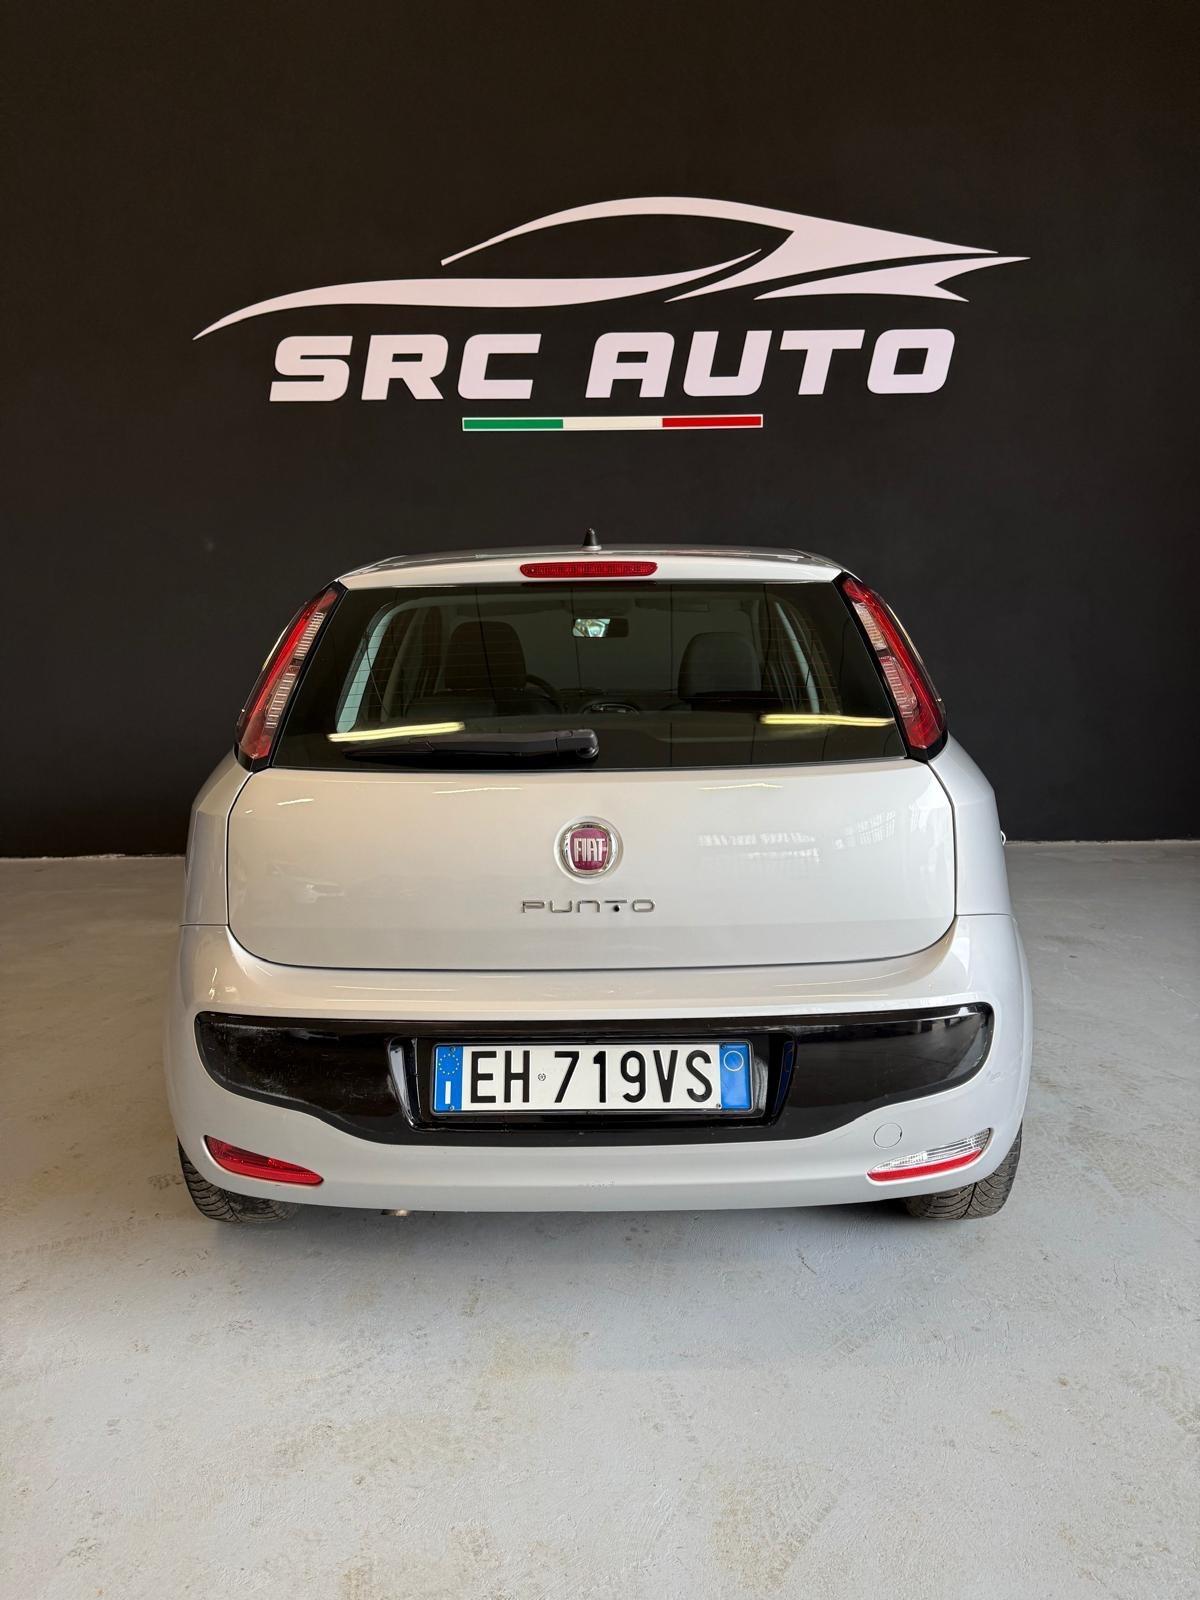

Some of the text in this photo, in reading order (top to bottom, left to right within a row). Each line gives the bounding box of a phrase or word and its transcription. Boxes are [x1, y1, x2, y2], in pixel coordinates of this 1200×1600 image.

[269, 328, 955, 402] SRC AUTO
[573, 837, 606, 862] FIAT
[521, 899, 656, 913] PUNTO
